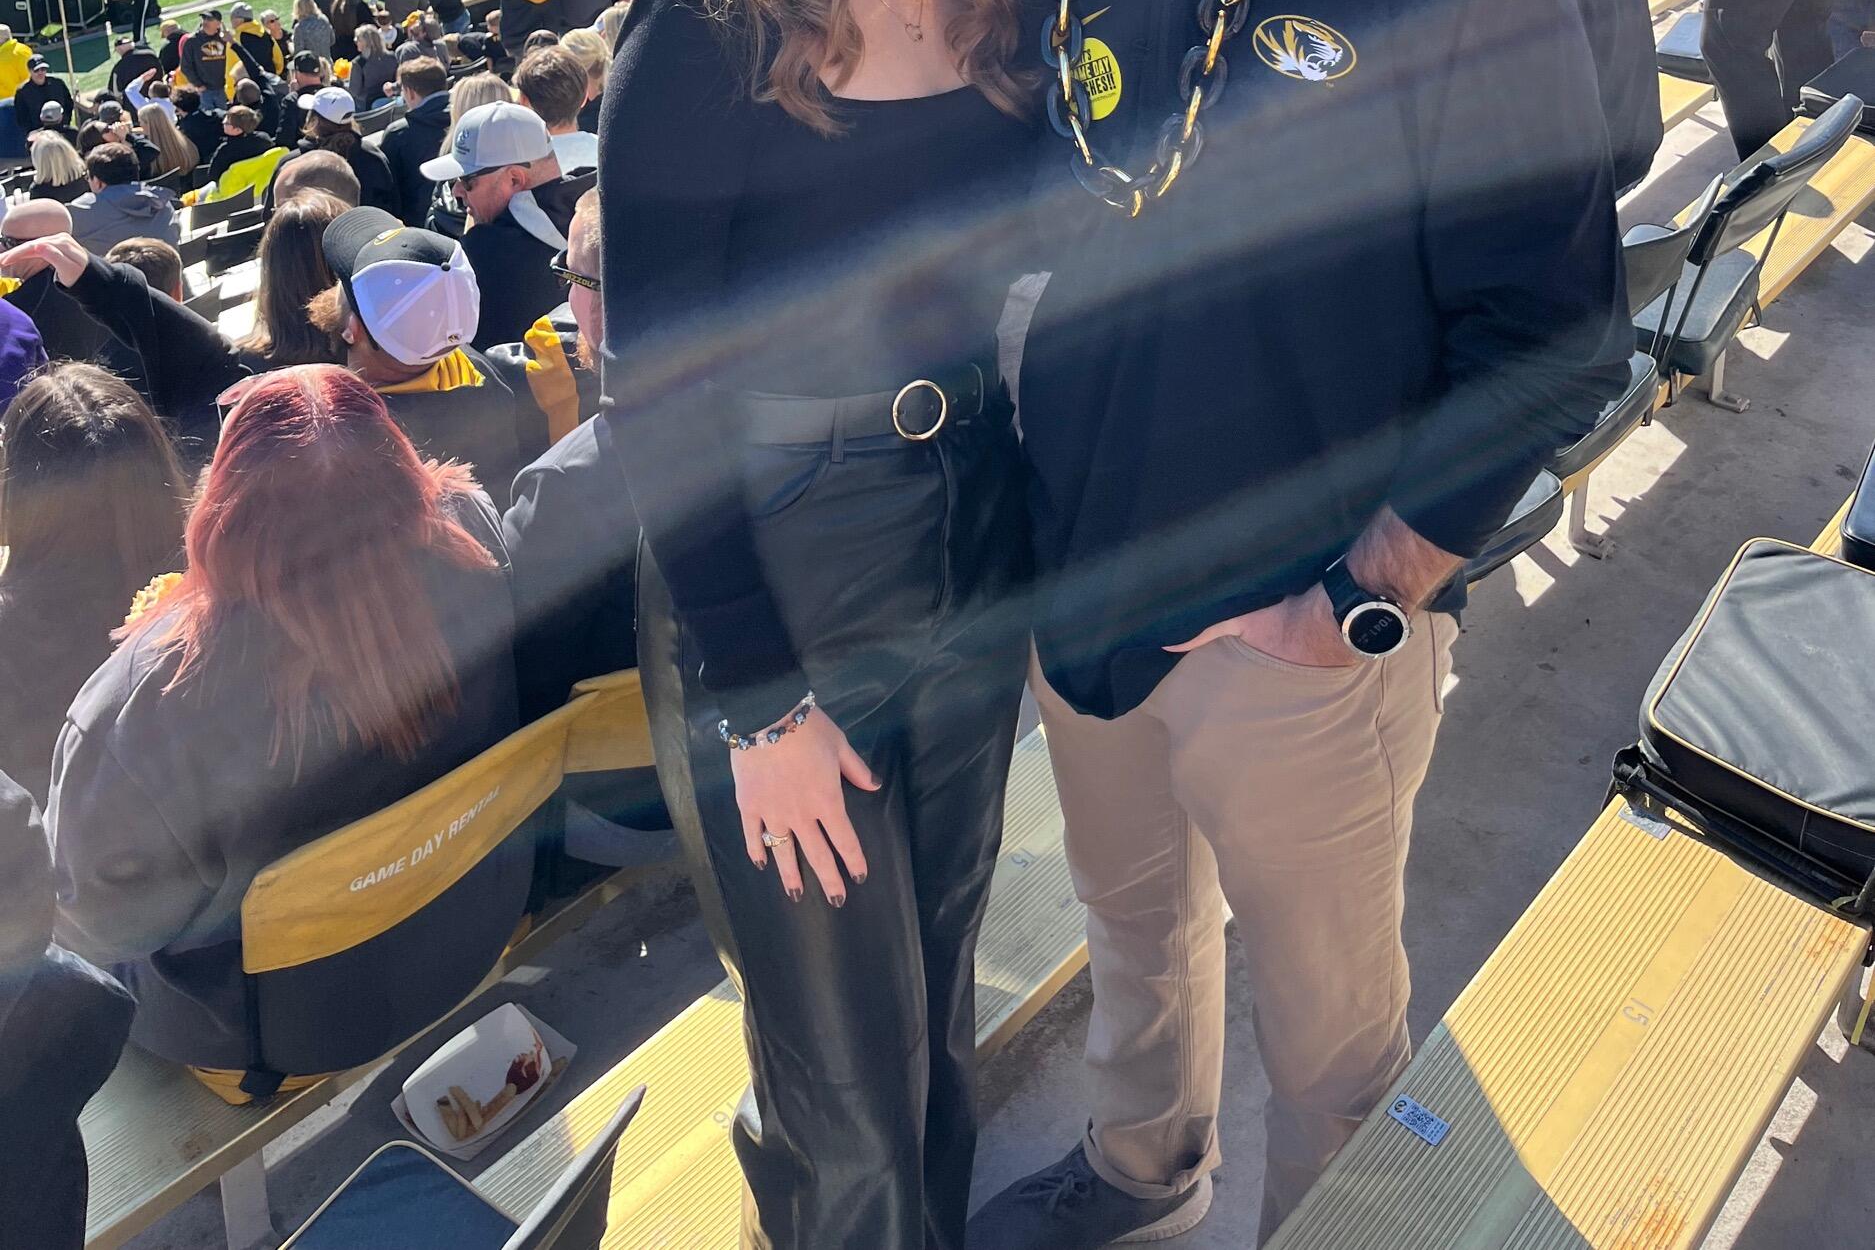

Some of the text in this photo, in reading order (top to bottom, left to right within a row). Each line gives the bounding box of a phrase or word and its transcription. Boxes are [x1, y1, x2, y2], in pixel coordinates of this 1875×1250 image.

[1092, 56, 1112, 76] DAY
[562, 271, 593, 287] MIZZOU
[349, 785, 500, 892] GAME DAY RENTAL
